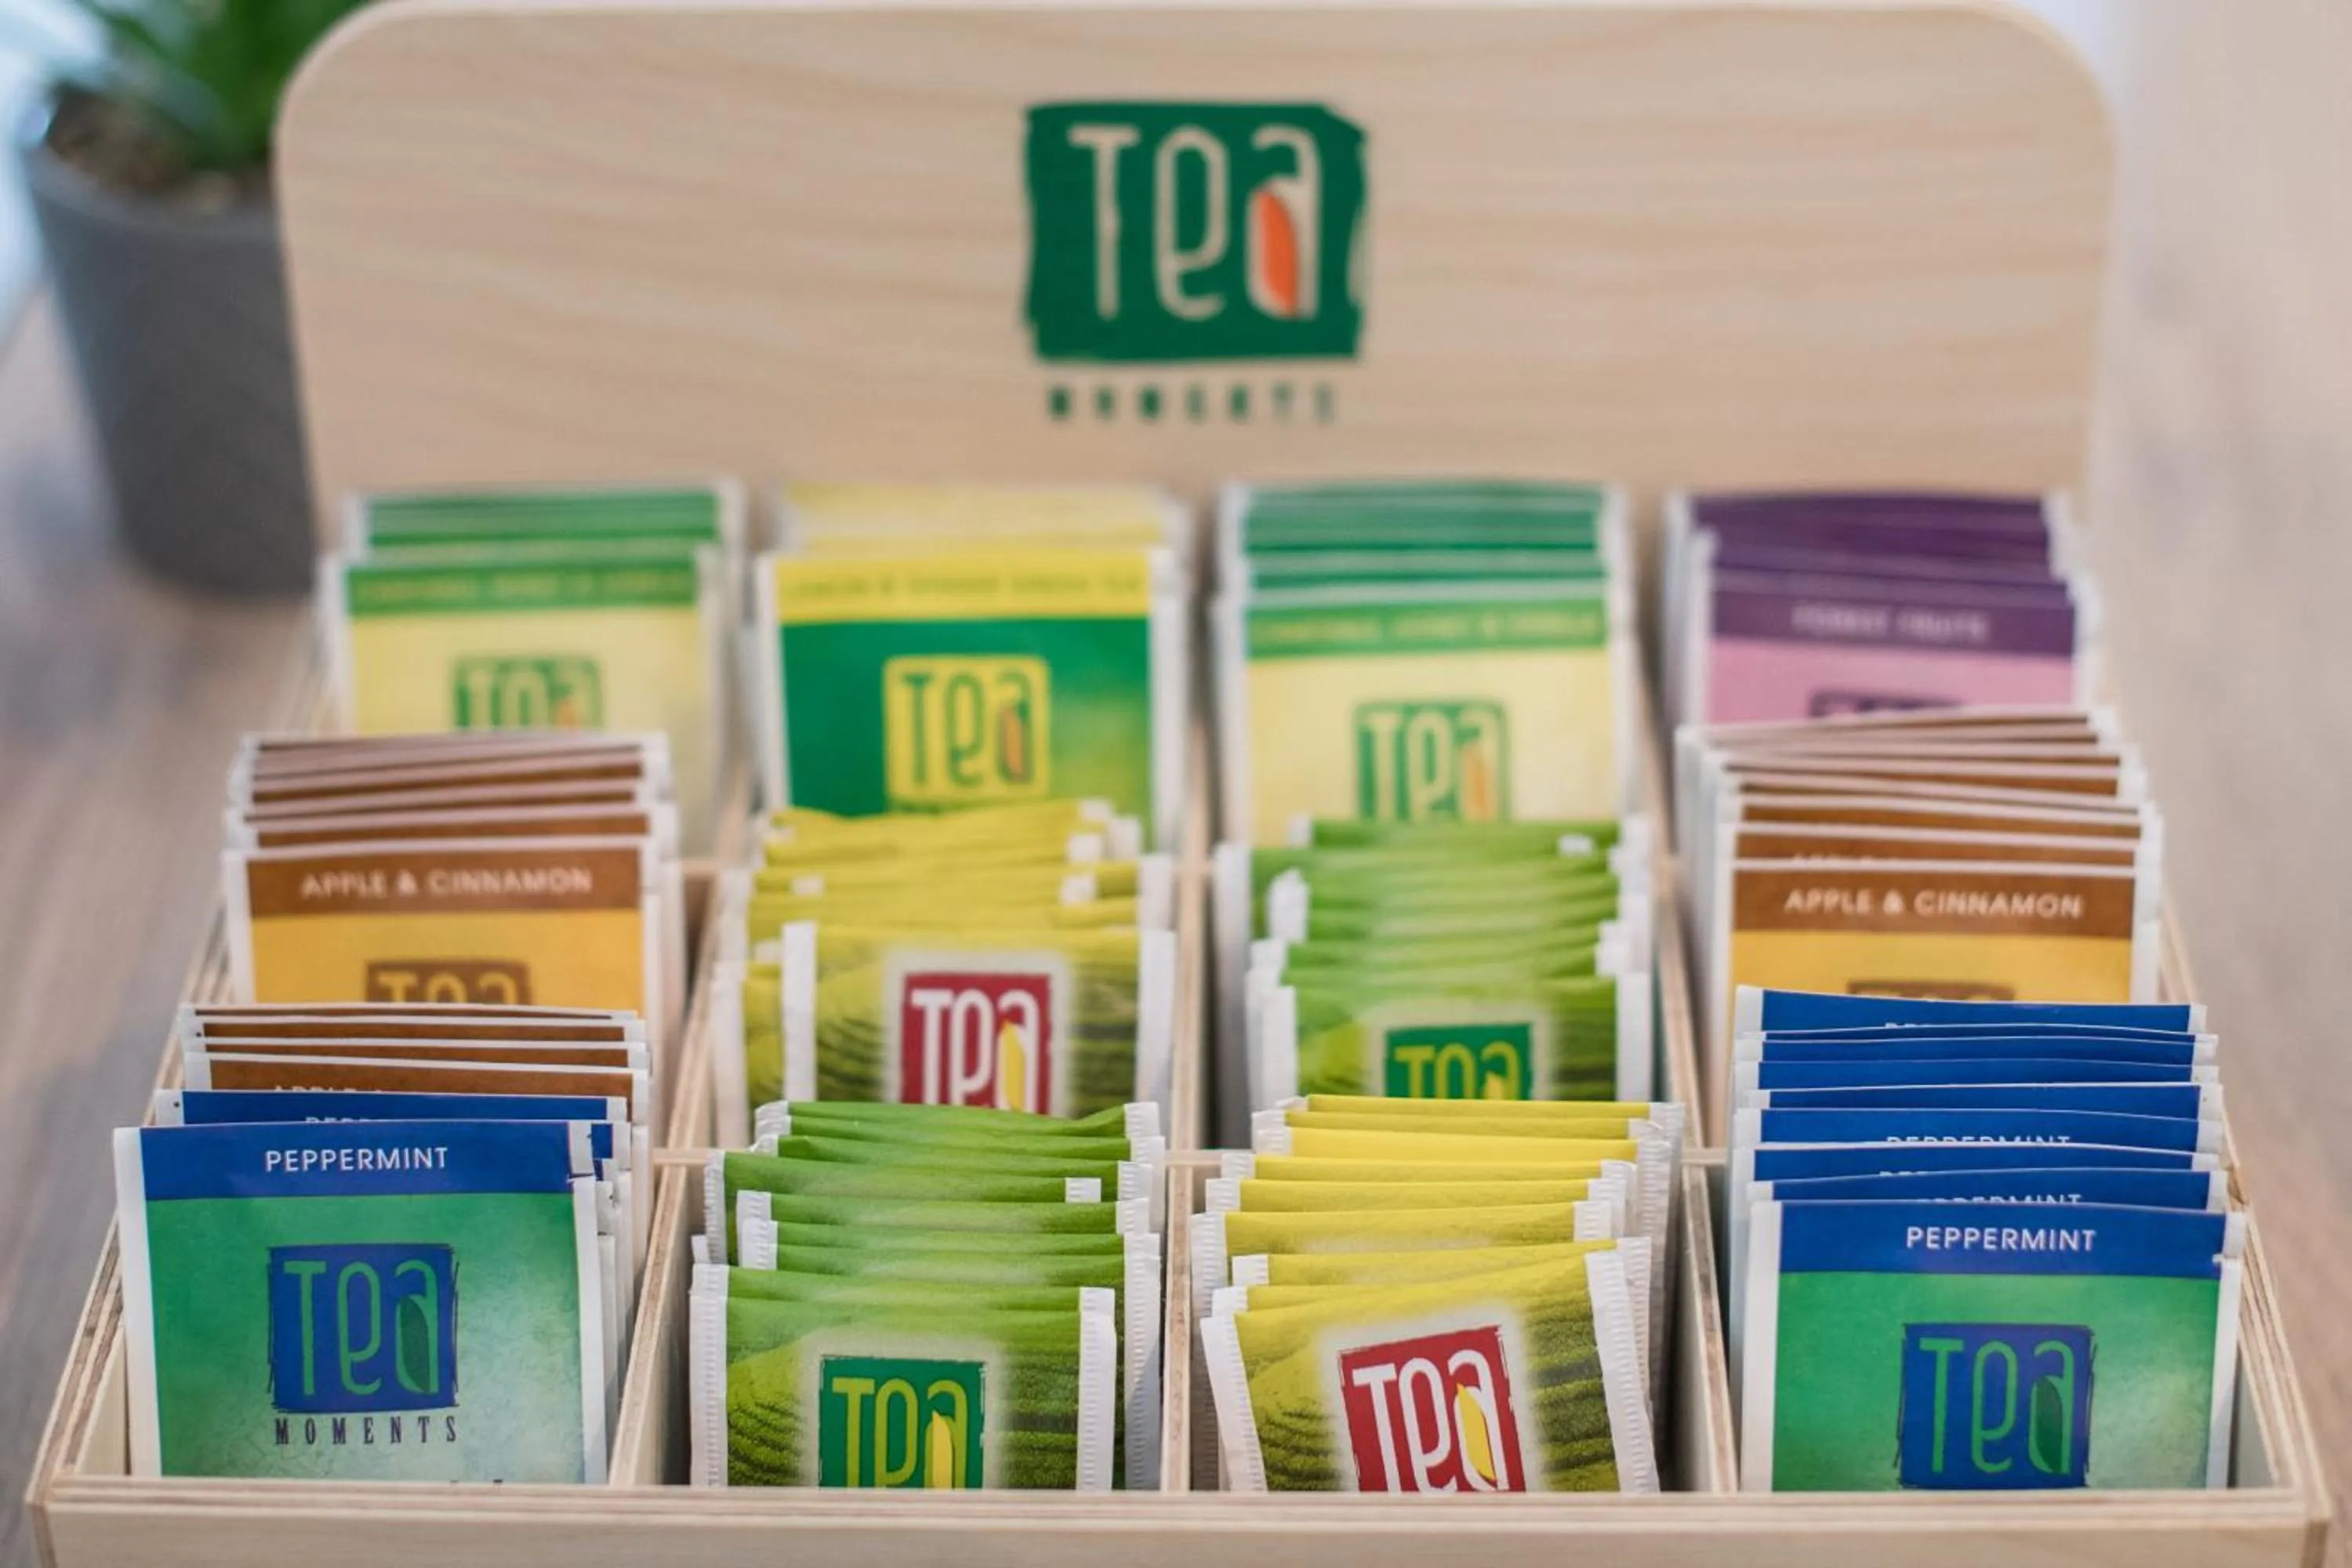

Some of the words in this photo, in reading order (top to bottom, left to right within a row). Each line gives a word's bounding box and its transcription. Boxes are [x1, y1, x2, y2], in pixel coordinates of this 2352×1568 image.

[1066, 123, 1321, 321] Tea
[301, 870, 387, 898] APPLE
[397, 869, 418, 896] &
[428, 867, 593, 895] CINNAMON
[1784, 888, 1871, 916] APPLE
[1883, 888, 1905, 916] &
[1914, 889, 2084, 919] CINNAMON
[265, 1146, 448, 1173] PEPPERMINT
[1906, 1226, 2097, 1251] PEPPERMINT
[283, 1259, 439, 1396] Tea
[1352, 1349, 1511, 1493] Tea
[1919, 1337, 2074, 1475] Tea
[274, 1416, 458, 1446] MOMENTS
